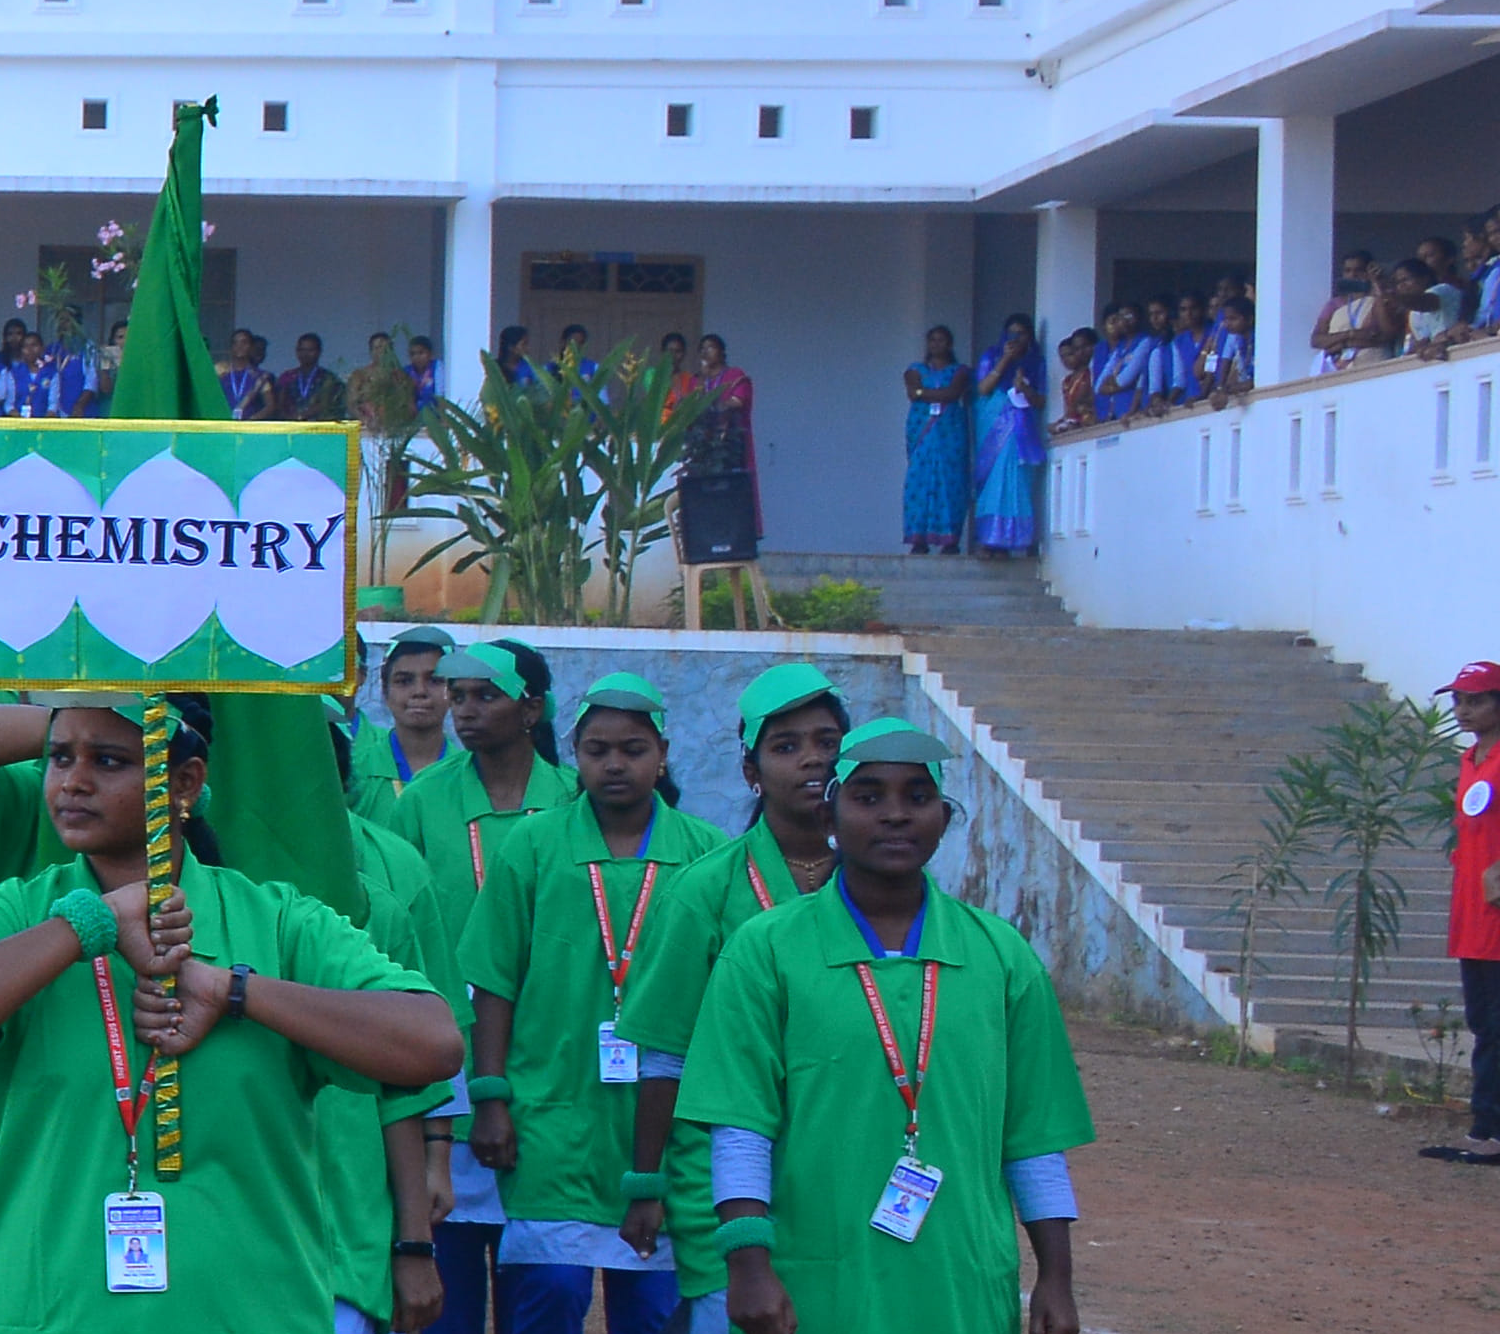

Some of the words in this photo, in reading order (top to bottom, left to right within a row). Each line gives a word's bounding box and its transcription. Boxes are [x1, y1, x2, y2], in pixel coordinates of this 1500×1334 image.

[99, 977, 107, 988] OF
[101, 987, 115, 1022] COLLEGE
[109, 1021, 121, 1049] JESUS
[112, 1048, 125, 1080] INFANT
